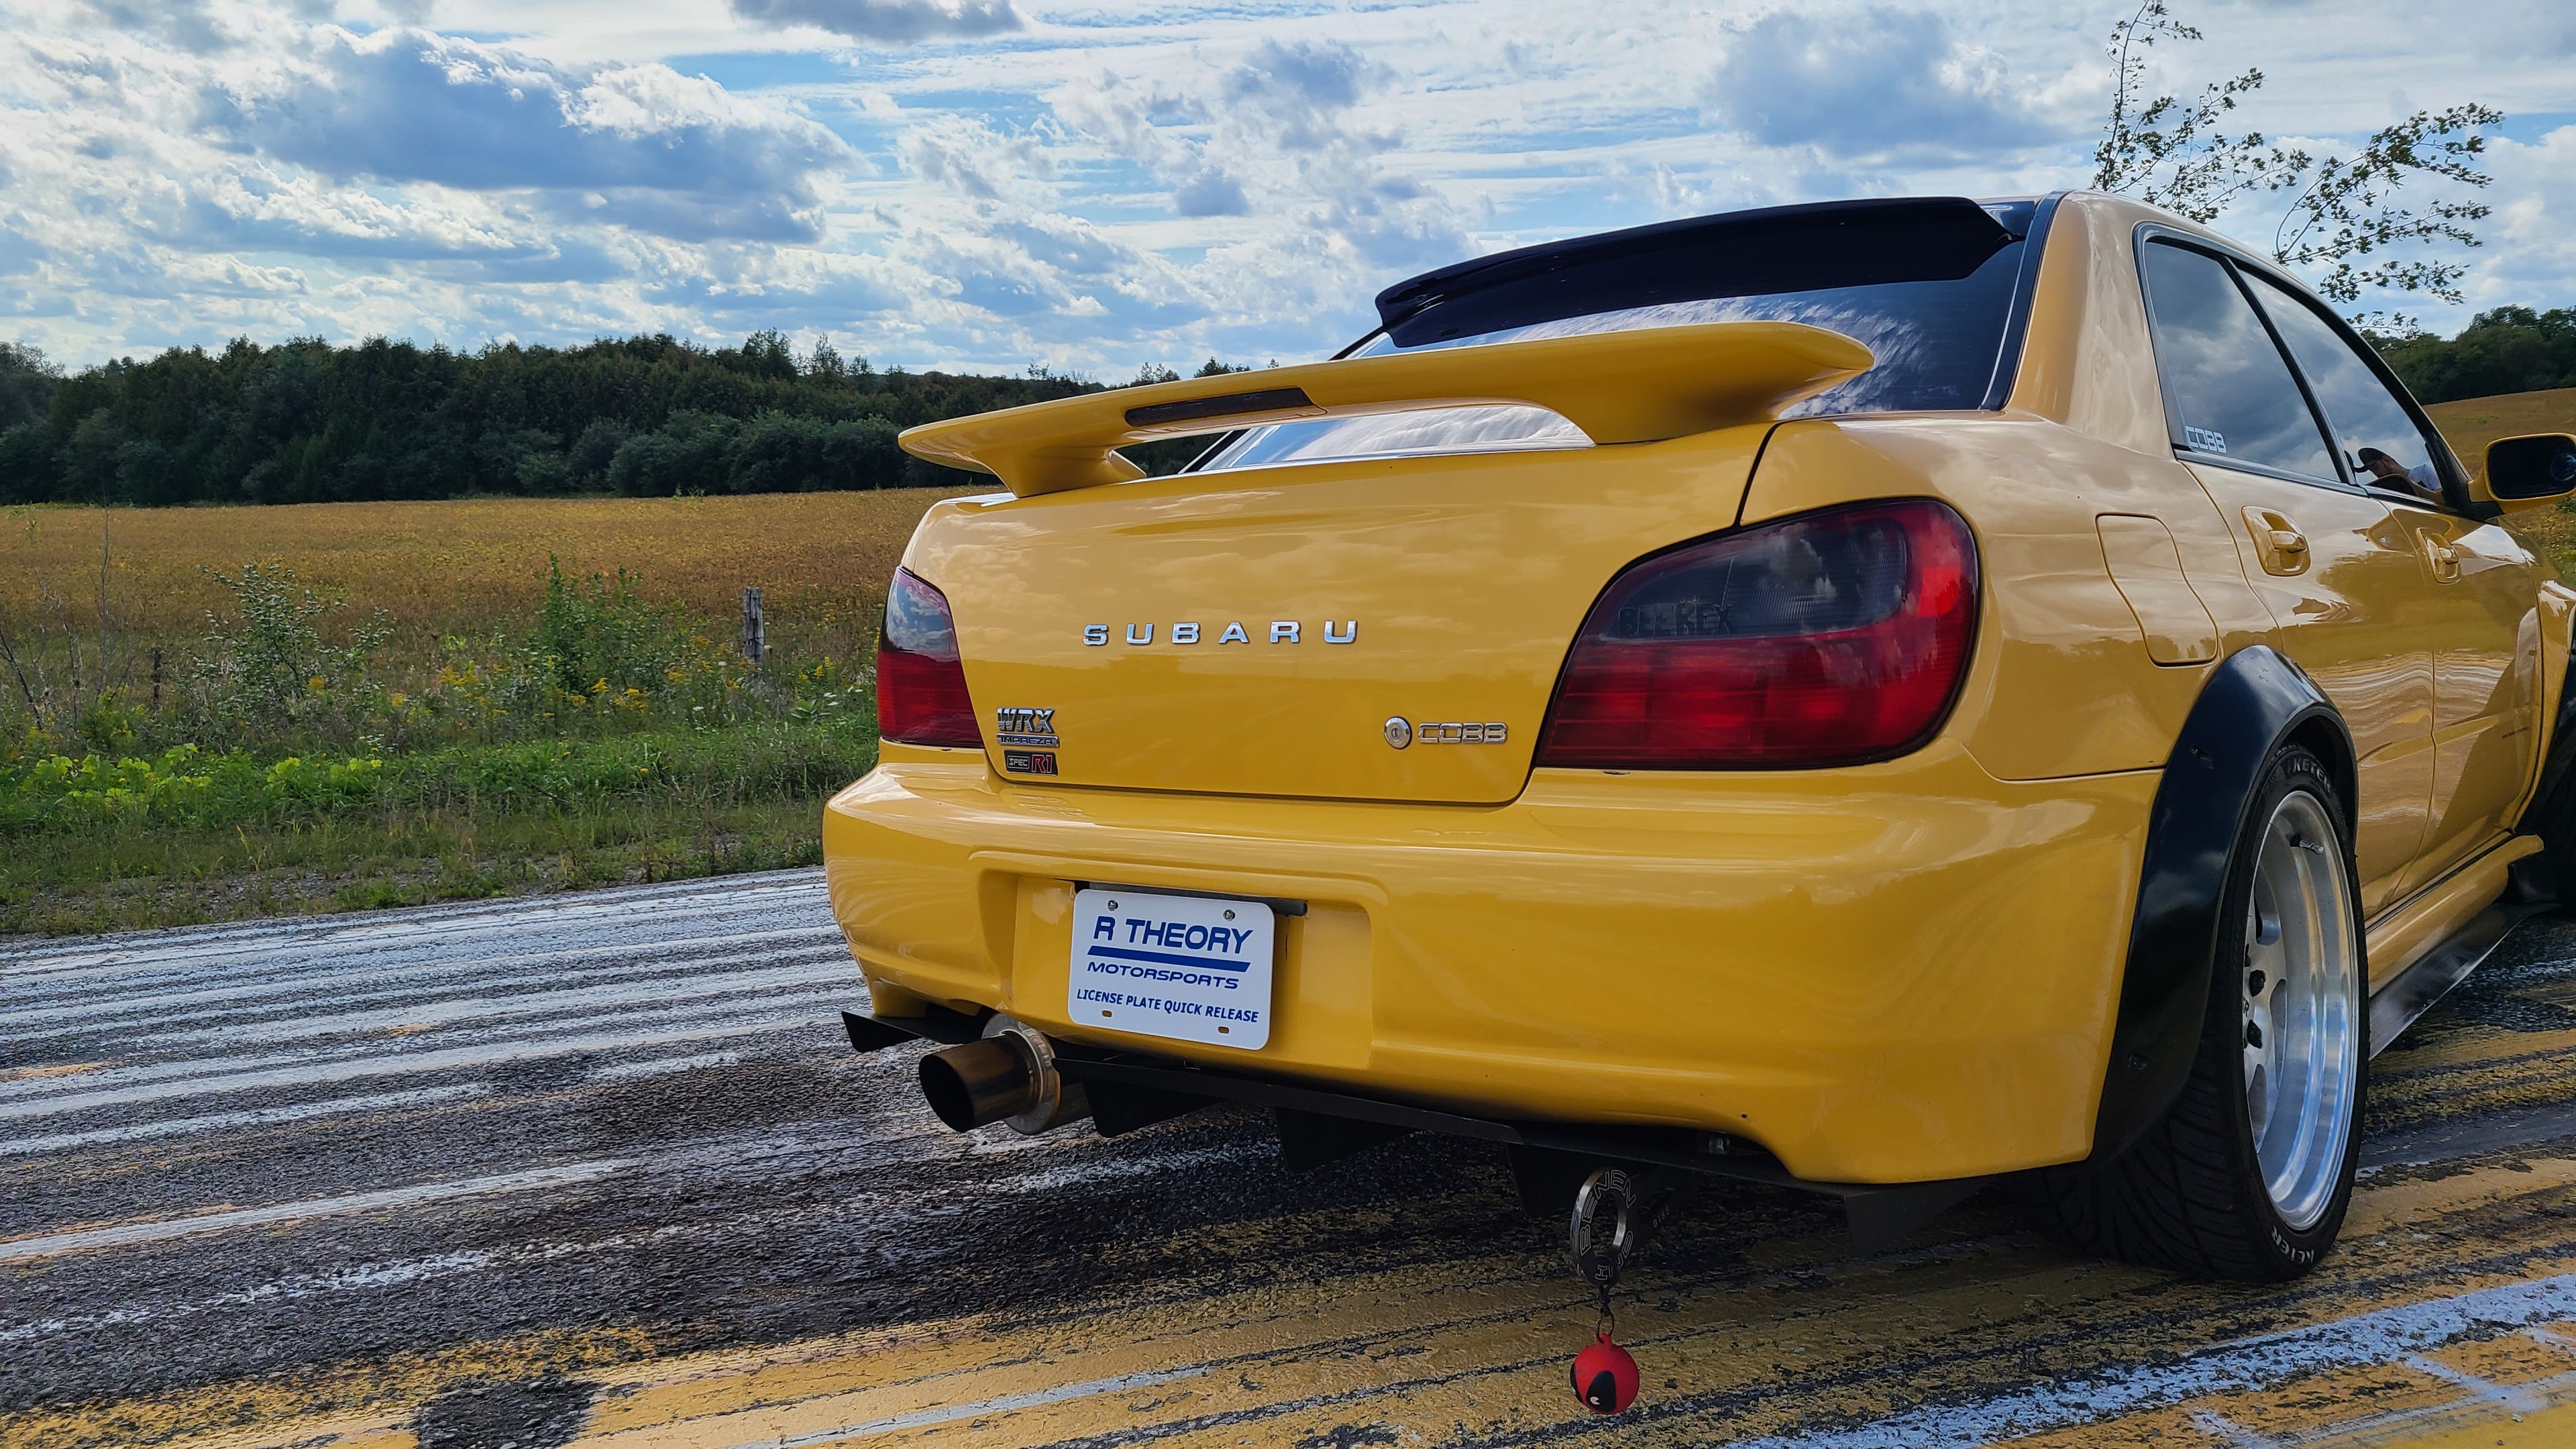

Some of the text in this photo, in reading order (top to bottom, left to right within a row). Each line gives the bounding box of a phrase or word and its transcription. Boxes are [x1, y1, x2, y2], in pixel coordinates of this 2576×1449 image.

[2185, 425, 2226, 453] COBB
[1083, 620, 1358, 645] SUBARU
[997, 707, 1055, 733] WRX
[1417, 722, 1508, 744] COBB
[1000, 736, 1053, 745] IMPREZA
[1008, 757, 1028, 767] SPEC
[1093, 916, 1253, 954] R THEORY
[1087, 961, 1240, 989] MOTORSPORTS
[1077, 989, 1259, 1023] LICENSE PLATE QUICK RELEASE
[1580, 1169, 1637, 1256] BENEN
